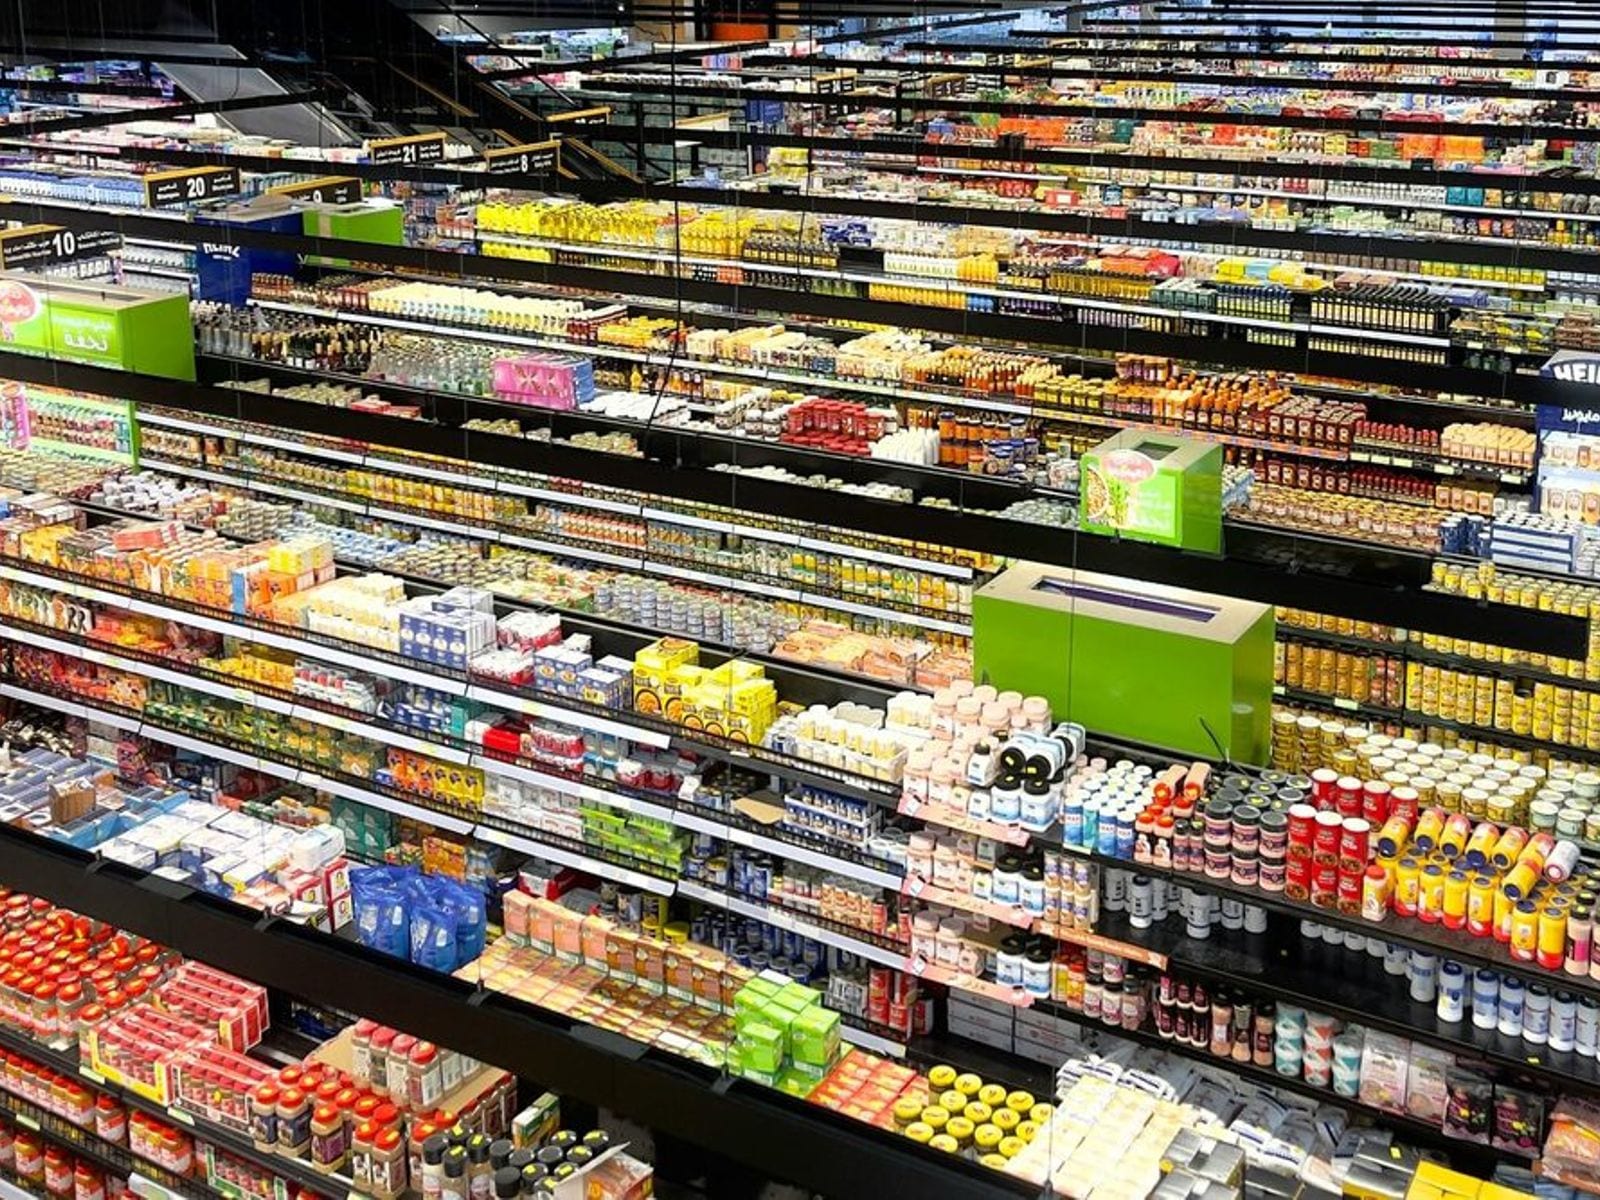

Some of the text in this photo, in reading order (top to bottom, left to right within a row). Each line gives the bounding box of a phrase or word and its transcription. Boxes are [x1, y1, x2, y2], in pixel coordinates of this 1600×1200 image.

[403, 145, 416, 163] 21
[521, 154, 528, 173] 8
[187, 177, 205, 198] 20
[52, 231, 75, 256] 10
